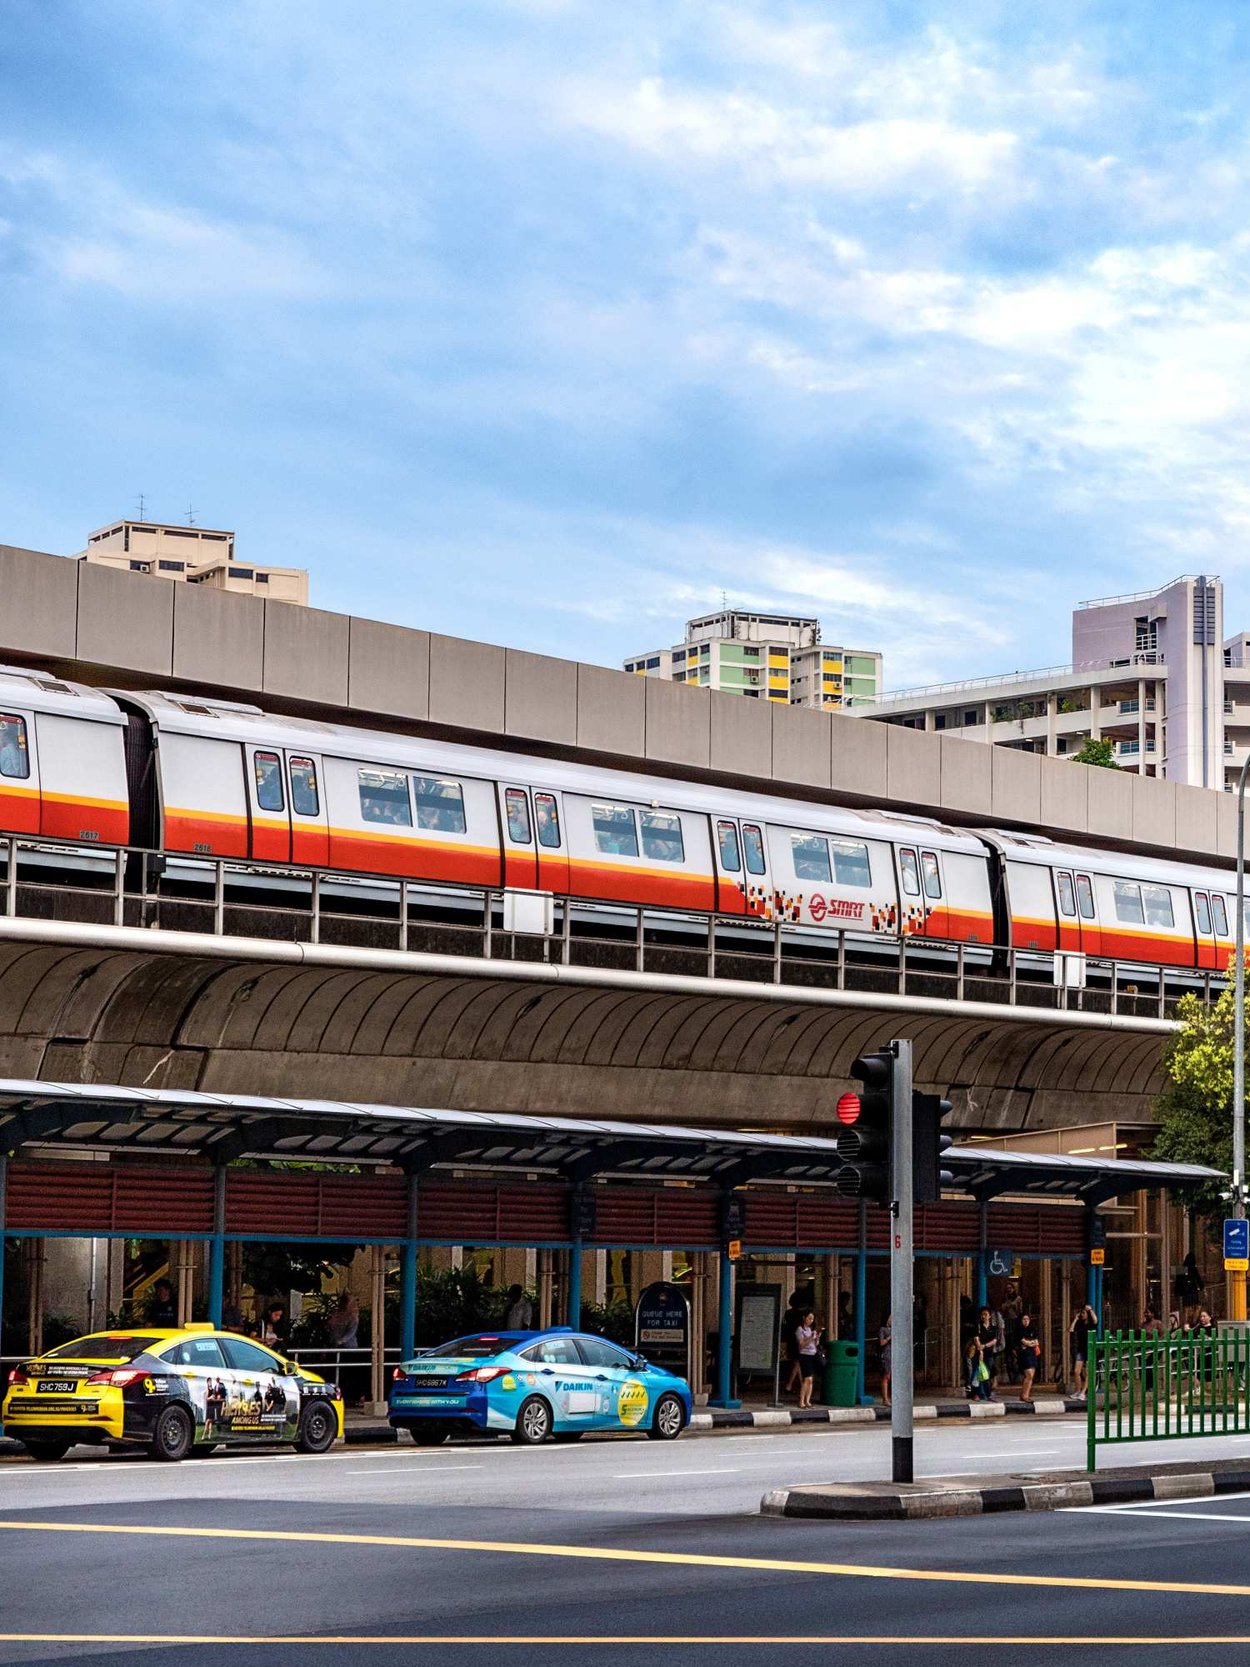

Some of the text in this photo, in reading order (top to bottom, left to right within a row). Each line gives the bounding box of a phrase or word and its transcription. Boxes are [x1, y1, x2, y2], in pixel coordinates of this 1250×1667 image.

[828, 899, 865, 918] SMRT
[642, 1310, 683, 1318] QUEUE HERE
[648, 1319, 678, 1327] FOR TAXI
[40, 1382, 74, 1392] SHC759J
[563, 1382, 593, 1392] DAIKIN
